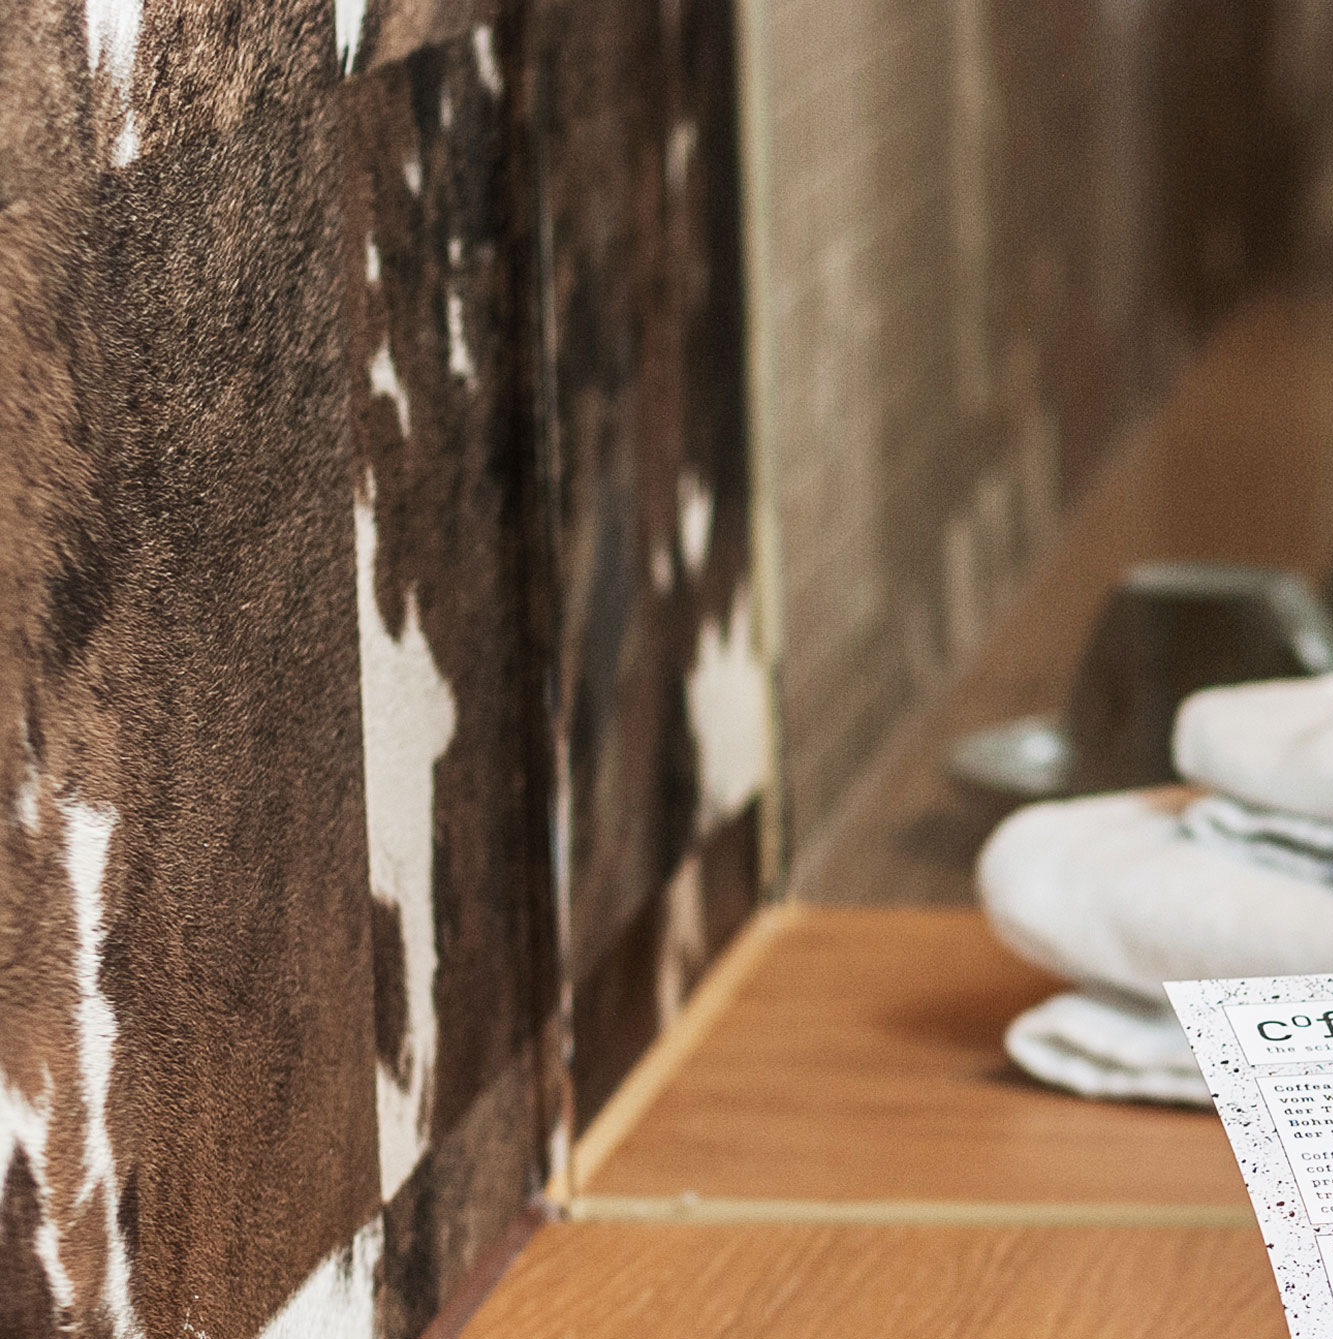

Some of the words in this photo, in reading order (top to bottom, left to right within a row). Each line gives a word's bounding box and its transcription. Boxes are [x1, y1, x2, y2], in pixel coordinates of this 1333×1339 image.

[1266, 1046, 1296, 1054] the
[1273, 1083, 1333, 1093] Coffea
[1279, 1096, 1315, 1104] vom
[1283, 1107, 1313, 1116] der
[1293, 1131, 1323, 1139] der
